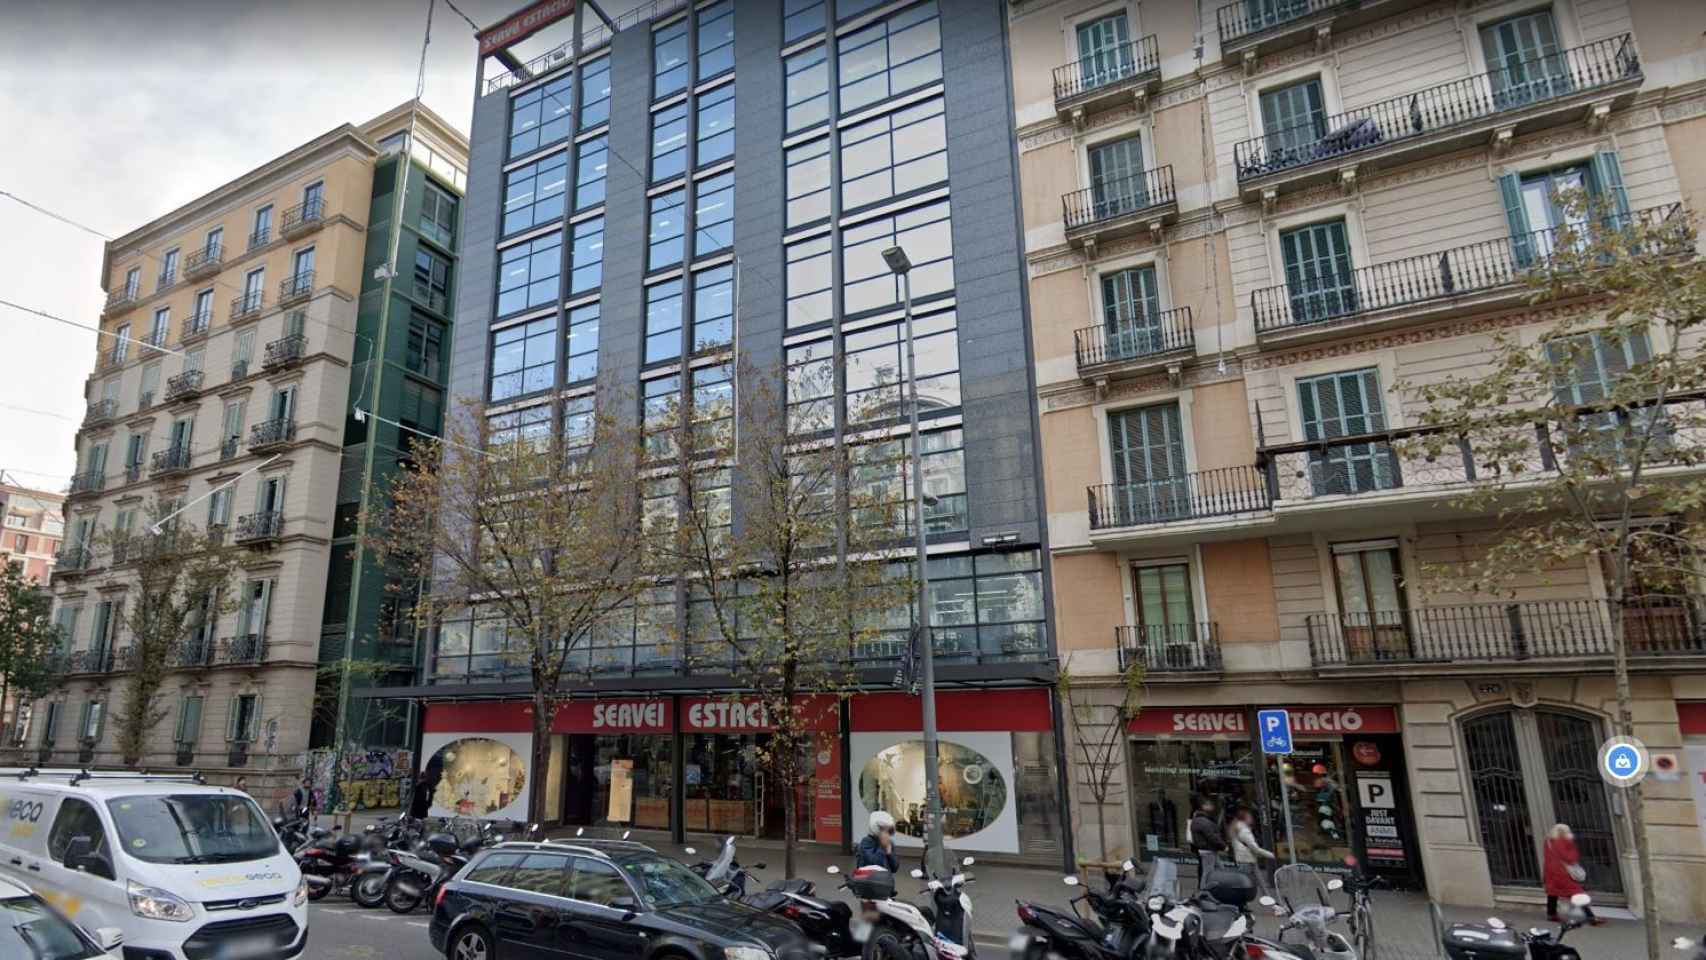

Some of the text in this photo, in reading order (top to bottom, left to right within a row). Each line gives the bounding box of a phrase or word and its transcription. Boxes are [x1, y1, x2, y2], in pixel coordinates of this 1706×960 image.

[592, 702, 770, 728] SERVEI ESTACI
[1172, 708, 1363, 731] SERVEI TACIÓ
[1267, 717, 1280, 732] P
[1367, 784, 1384, 803] P
[1365, 816, 1396, 825] DAVANT
